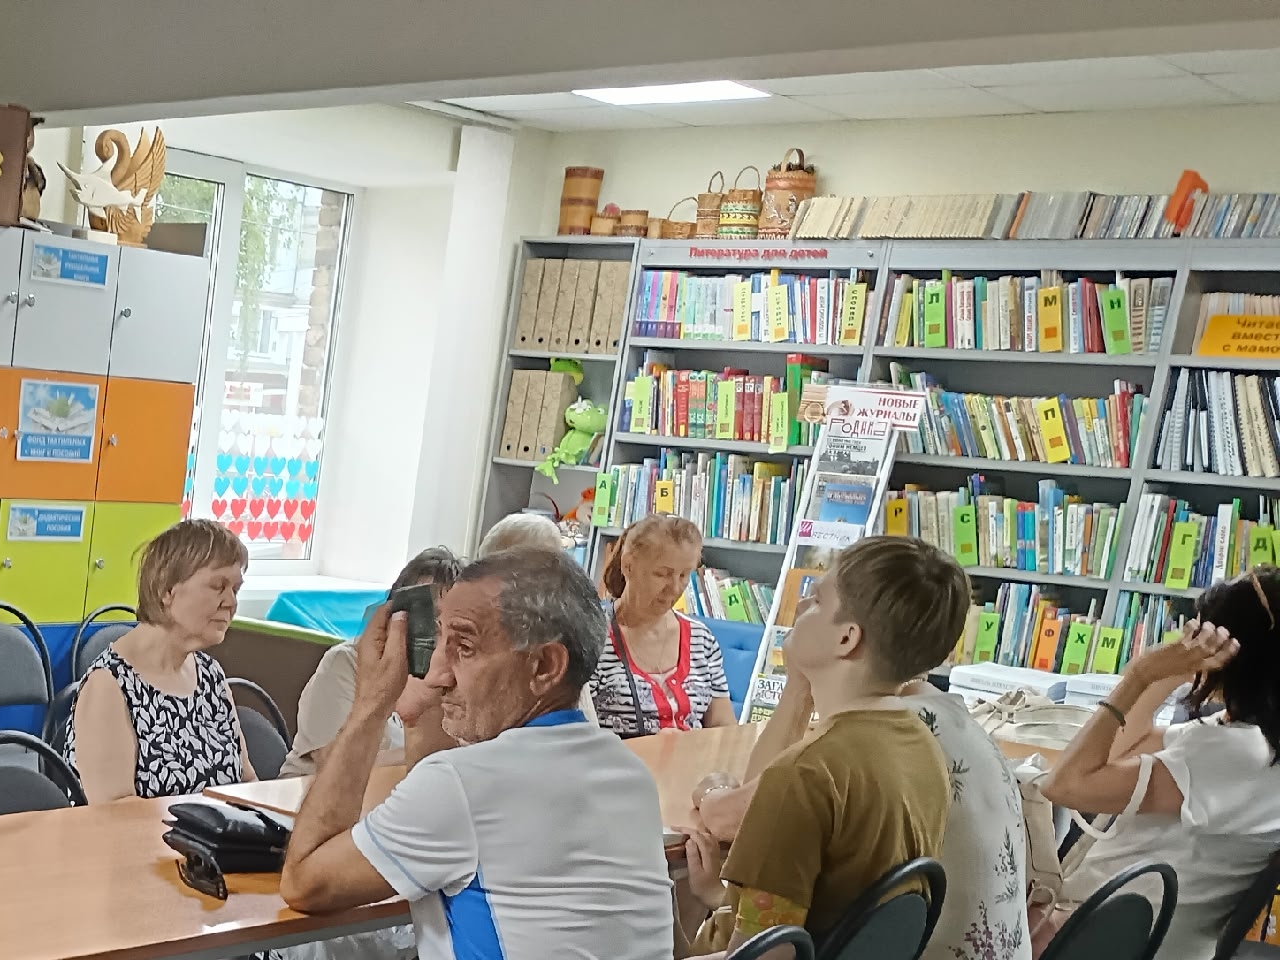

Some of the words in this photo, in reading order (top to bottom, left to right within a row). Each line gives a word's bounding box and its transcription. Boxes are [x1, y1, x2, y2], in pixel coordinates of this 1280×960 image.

[1044, 296, 1057, 307] М
[1223, 344, 1231, 352] с
[878, 397, 919, 409] НОВЫЕ
[856, 409, 917, 422] ЖУРНАЛЫ
[1044, 408, 1056, 420] П
[599, 480, 607, 490] А
[660, 488, 669, 497] Б
[894, 508, 903, 518] Р
[960, 514, 970, 523] С
[1181, 534, 1192, 546] Г
[1254, 538, 1267, 551] Д
[985, 621, 994, 631] У
[1044, 629, 1054, 637] Ф
[1075, 633, 1085, 644] Х
[1101, 637, 1115, 649] М
